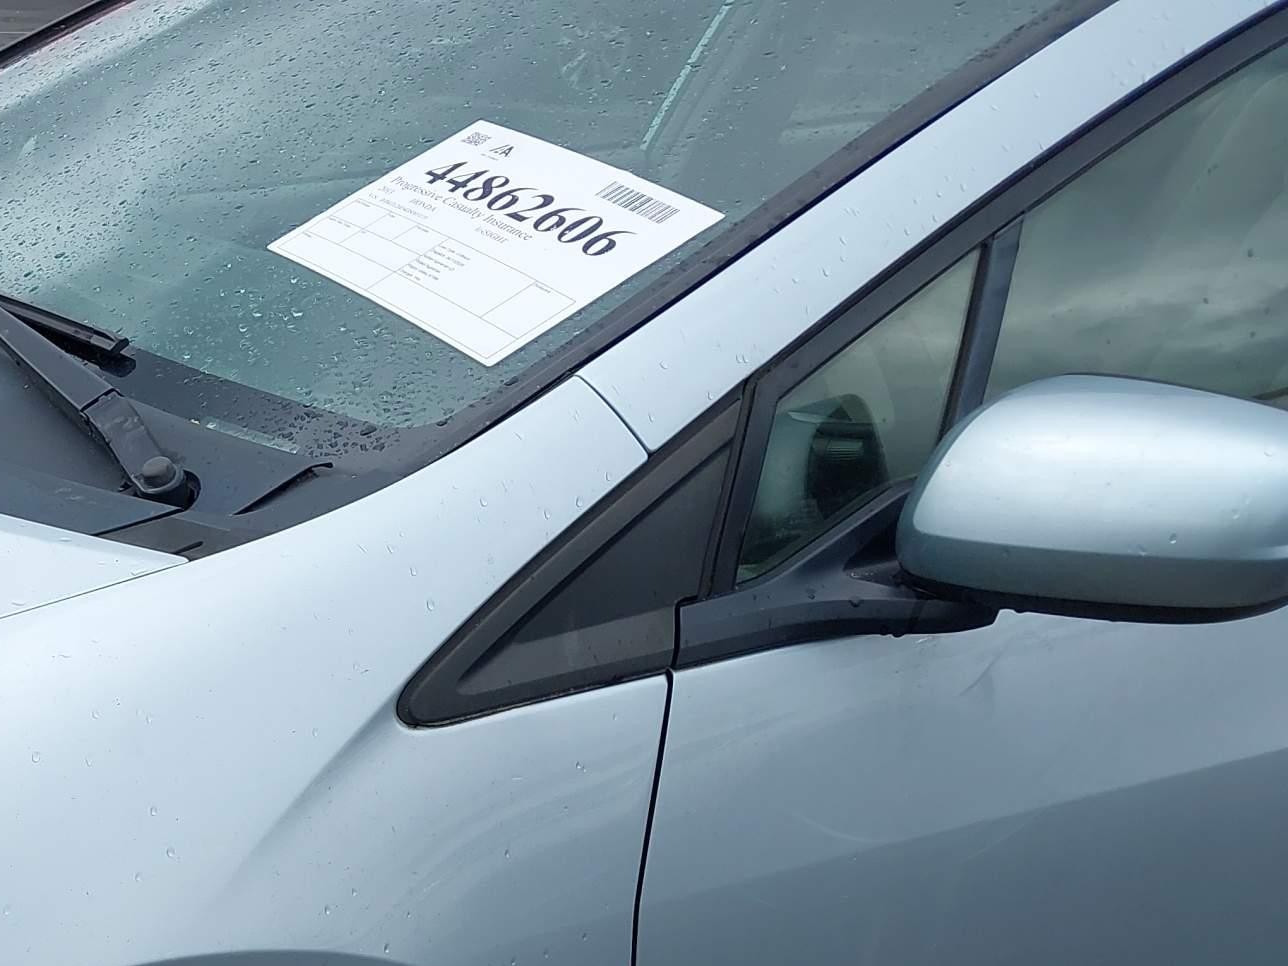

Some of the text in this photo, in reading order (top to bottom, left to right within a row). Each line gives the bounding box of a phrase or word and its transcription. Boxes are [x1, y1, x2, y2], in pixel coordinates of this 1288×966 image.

[390, 175, 443, 202] Progressive
[442, 196, 486, 220] Casualty
[482, 211, 534, 241] Insurance
[424, 161, 637, 257] 44862606
